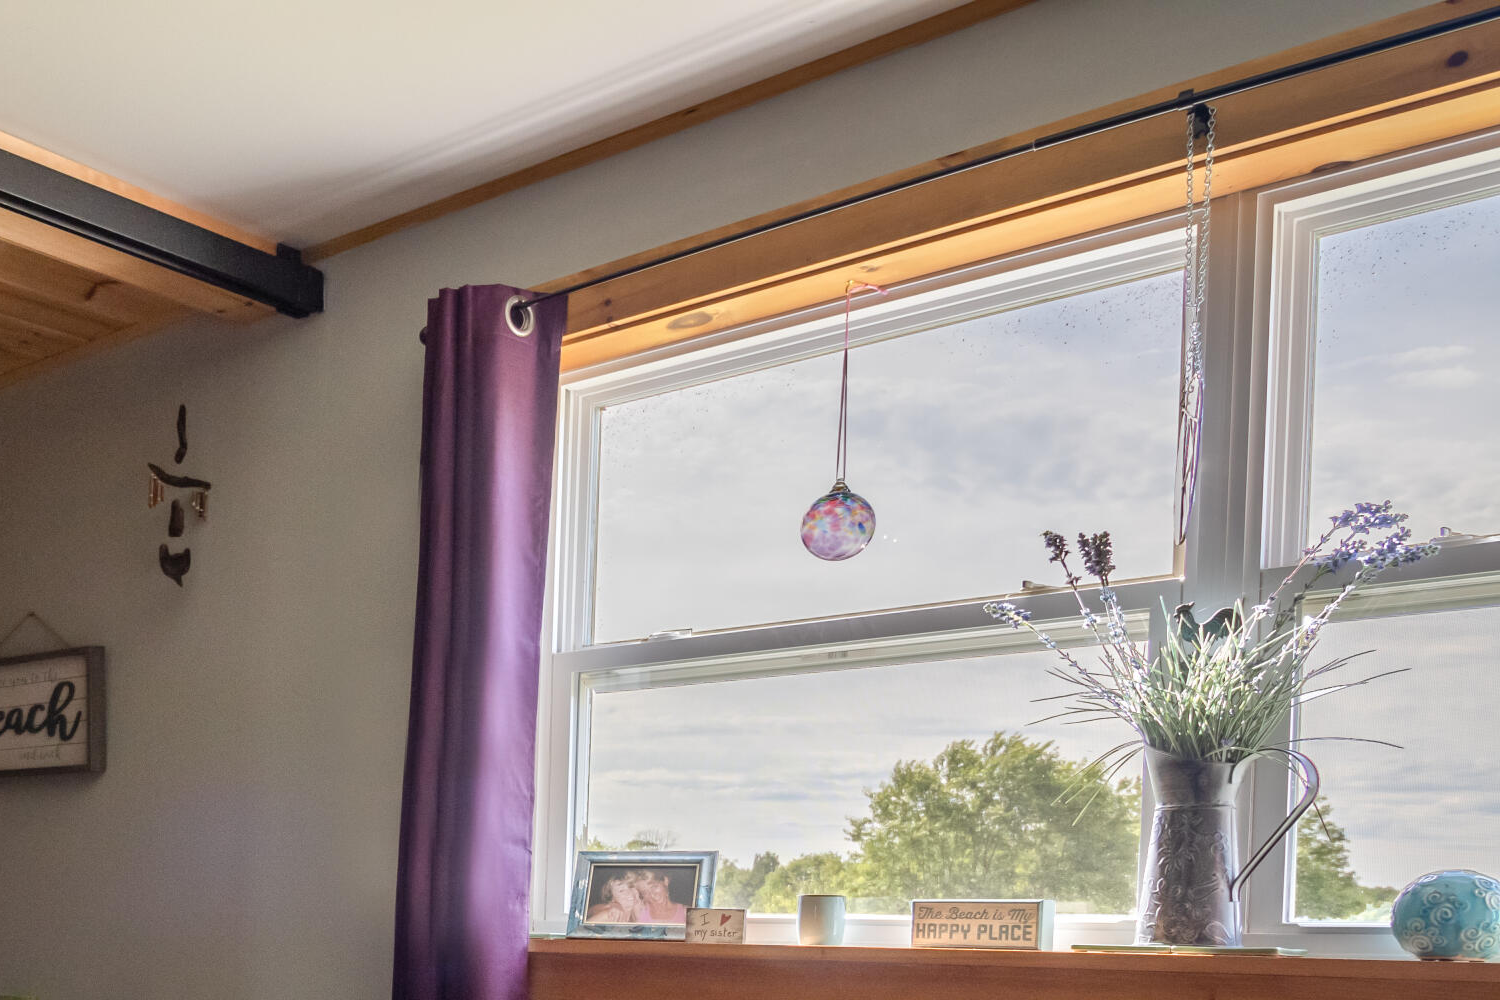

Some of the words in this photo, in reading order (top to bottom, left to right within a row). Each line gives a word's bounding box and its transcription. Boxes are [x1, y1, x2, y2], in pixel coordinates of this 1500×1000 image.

[700, 913, 711, 927] I
[918, 906, 942, 919] The
[946, 906, 989, 920] Beach
[993, 908, 1005, 920] is
[1007, 908, 1034, 924] My
[694, 929, 708, 941] my
[710, 927, 739, 938] sister
[916, 923, 971, 940] HAPPY
[977, 924, 1032, 941] PLACE
